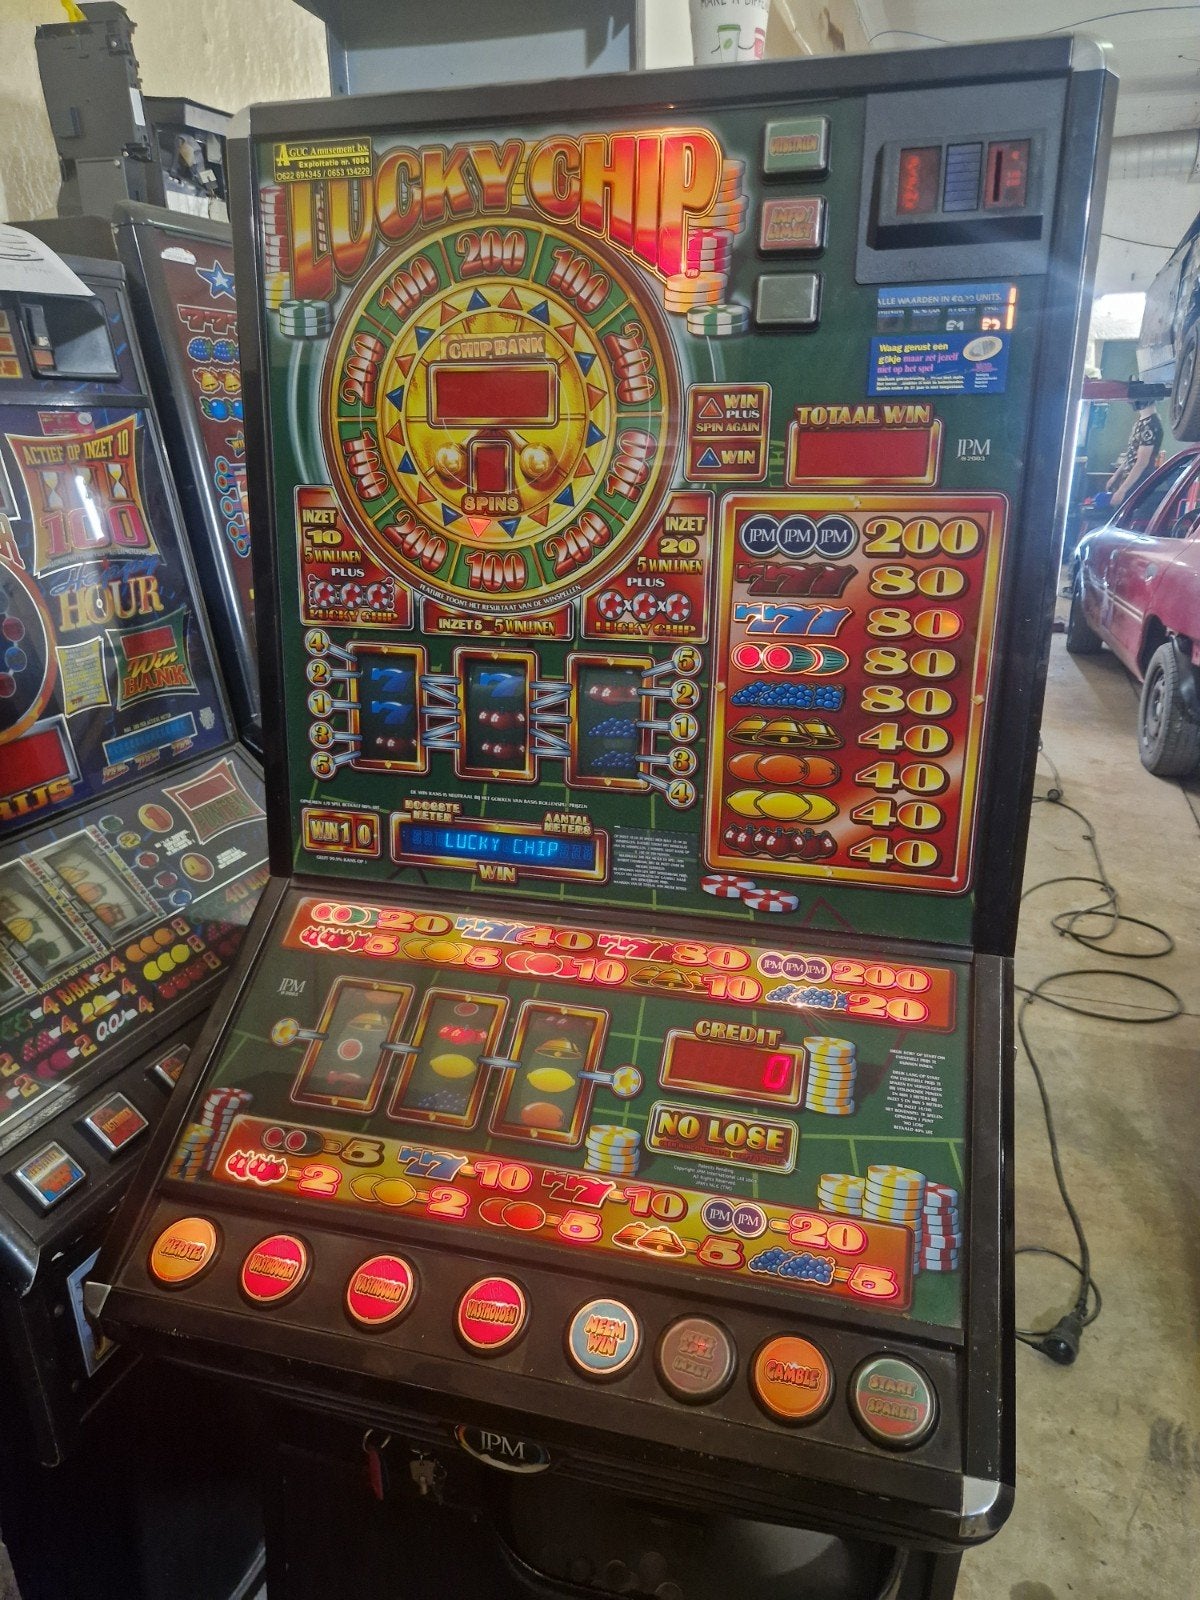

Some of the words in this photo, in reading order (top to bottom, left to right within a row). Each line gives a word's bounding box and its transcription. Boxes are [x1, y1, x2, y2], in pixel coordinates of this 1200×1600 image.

[298, 159, 339, 169] Exploitatie
[288, 138, 528, 302] LUCKY
[525, 125, 723, 284] CHIP
[456, 228, 527, 277] 200
[377, 254, 441, 321] 100
[547, 246, 613, 316] 100
[900, 294, 939, 305] WAARDEN
[941, 294, 951, 303] IN
[447, 340, 492, 361] CHIP
[494, 336, 545, 358] BANK
[880, 344, 903, 353] Waag
[904, 344, 931, 354] gerust
[342, 330, 389, 410] 200
[601, 322, 659, 406] 200
[724, 394, 758, 409] WIN
[726, 409, 760, 419] PLUS
[797, 406, 881, 427] TOTAAL
[883, 405, 931, 424] WIN
[695, 422, 724, 433] SPIN
[725, 422, 760, 433] AGAIN
[22, 445, 64, 466] ACTIEF
[66, 444, 80, 461] OP
[83, 435, 113, 459] INZET
[117, 428, 129, 456] 10
[721, 449, 756, 465] WIN
[957, 438, 991, 457] JPM
[341, 428, 390, 502] 100
[604, 429, 658, 503] 100
[302, 508, 337, 524] INZET
[463, 495, 520, 514] SPINS
[40, 501, 150, 557] 100
[665, 516, 705, 532] INZET
[747, 528, 777, 544] JPM
[782, 527, 812, 544] JPM
[818, 528, 849, 544] JPM
[864, 516, 980, 556] 200
[307, 529, 342, 544] 10
[382, 509, 451, 576] 200
[545, 511, 613, 577] 200
[660, 538, 697, 553] 20
[304, 546, 313, 563] 5
[637, 557, 647, 574] 5
[331, 567, 365, 578] PLUS
[466, 549, 528, 592] 100
[627, 577, 666, 587] PLUS
[869, 565, 966, 598] 80
[59, 576, 165, 633] HOUR
[446, 594, 468, 607] TOONT
[518, 602, 533, 610] VAN
[309, 609, 358, 622] LUCKY
[360, 611, 399, 623] CHIP
[438, 618, 473, 630] INZET
[474, 620, 483, 630] 5
[494, 619, 504, 632] 5
[867, 607, 962, 639] 80
[595, 621, 653, 635] LUCKY
[654, 624, 696, 636] CHIP
[309, 635, 326, 650] 4
[127, 651, 179, 679] Win
[678, 650, 695, 669] 5
[863, 646, 958, 678] 80
[122, 664, 189, 700] BANK
[311, 665, 325, 679] 2
[315, 695, 326, 713] 1
[677, 684, 694, 701] 2
[861, 684, 953, 716] 80
[313, 726, 328, 743] 3
[676, 717, 689, 737] 1
[857, 722, 950, 754] 40
[315, 756, 330, 774] 5
[672, 751, 690, 770] 3
[855, 760, 945, 793] 40
[669, 784, 690, 802] 4
[413, 810, 452, 822] METER
[544, 813, 590, 825] AANTAL
[851, 798, 942, 830] 40
[310, 818, 339, 842] WIN
[340, 822, 351, 844] 1
[357, 823, 371, 847] 0
[543, 822, 592, 836] METERS
[445, 832, 500, 851] LUCKY
[512, 838, 559, 857] CHIP
[849, 836, 939, 868] 40
[478, 864, 516, 882] WIN
[376, 909, 452, 936] 20
[516, 926, 595, 950] 40
[670, 942, 751, 971] 80
[785, 962, 806, 974] JPM
[831, 960, 932, 993] 200
[121, 977, 138, 995] 4
[277, 977, 308, 993] JPM
[362, 934, 400, 956] 5
[464, 946, 502, 969] 5
[572, 957, 628, 985] 10
[703, 974, 763, 1002] 10
[845, 992, 929, 1024] 20
[43, 995, 61, 1015] 4
[138, 995, 155, 1014] 4
[61, 1014, 79, 1034] 4
[695, 1019, 782, 1048] CREDIT
[74, 1034, 98, 1058] 2
[0, 1053, 20, 1078] 2
[762, 1054, 791, 1090] 0
[14, 1073, 40, 1098] 2
[657, 1111, 700, 1139] NO
[708, 1119, 785, 1153] LOSE
[339, 1138, 386, 1166] 5
[474, 1160, 534, 1193] 10
[623, 1185, 688, 1220] 10
[707, 1208, 732, 1223] JPM
[736, 1213, 760, 1227] JPM
[788, 1213, 867, 1254] 20
[298, 1163, 342, 1196] 2
[426, 1185, 471, 1219] 2
[556, 1209, 603, 1243] 5
[697, 1235, 746, 1270] 5
[846, 1264, 898, 1300] 5
[250, 1254, 299, 1281] VASTHOUDEN
[354, 1274, 406, 1302] VASTHOUDEN
[466, 1299, 519, 1325] VASTHOUDEN
[584, 1315, 627, 1341] NEEM
[587, 1333, 618, 1357] WIN
[764, 1359, 822, 1390] GAMBLE
[869, 1374, 918, 1398] START
[866, 1397, 919, 1422] SPAREN
[480, 1430, 526, 1459] JPM
